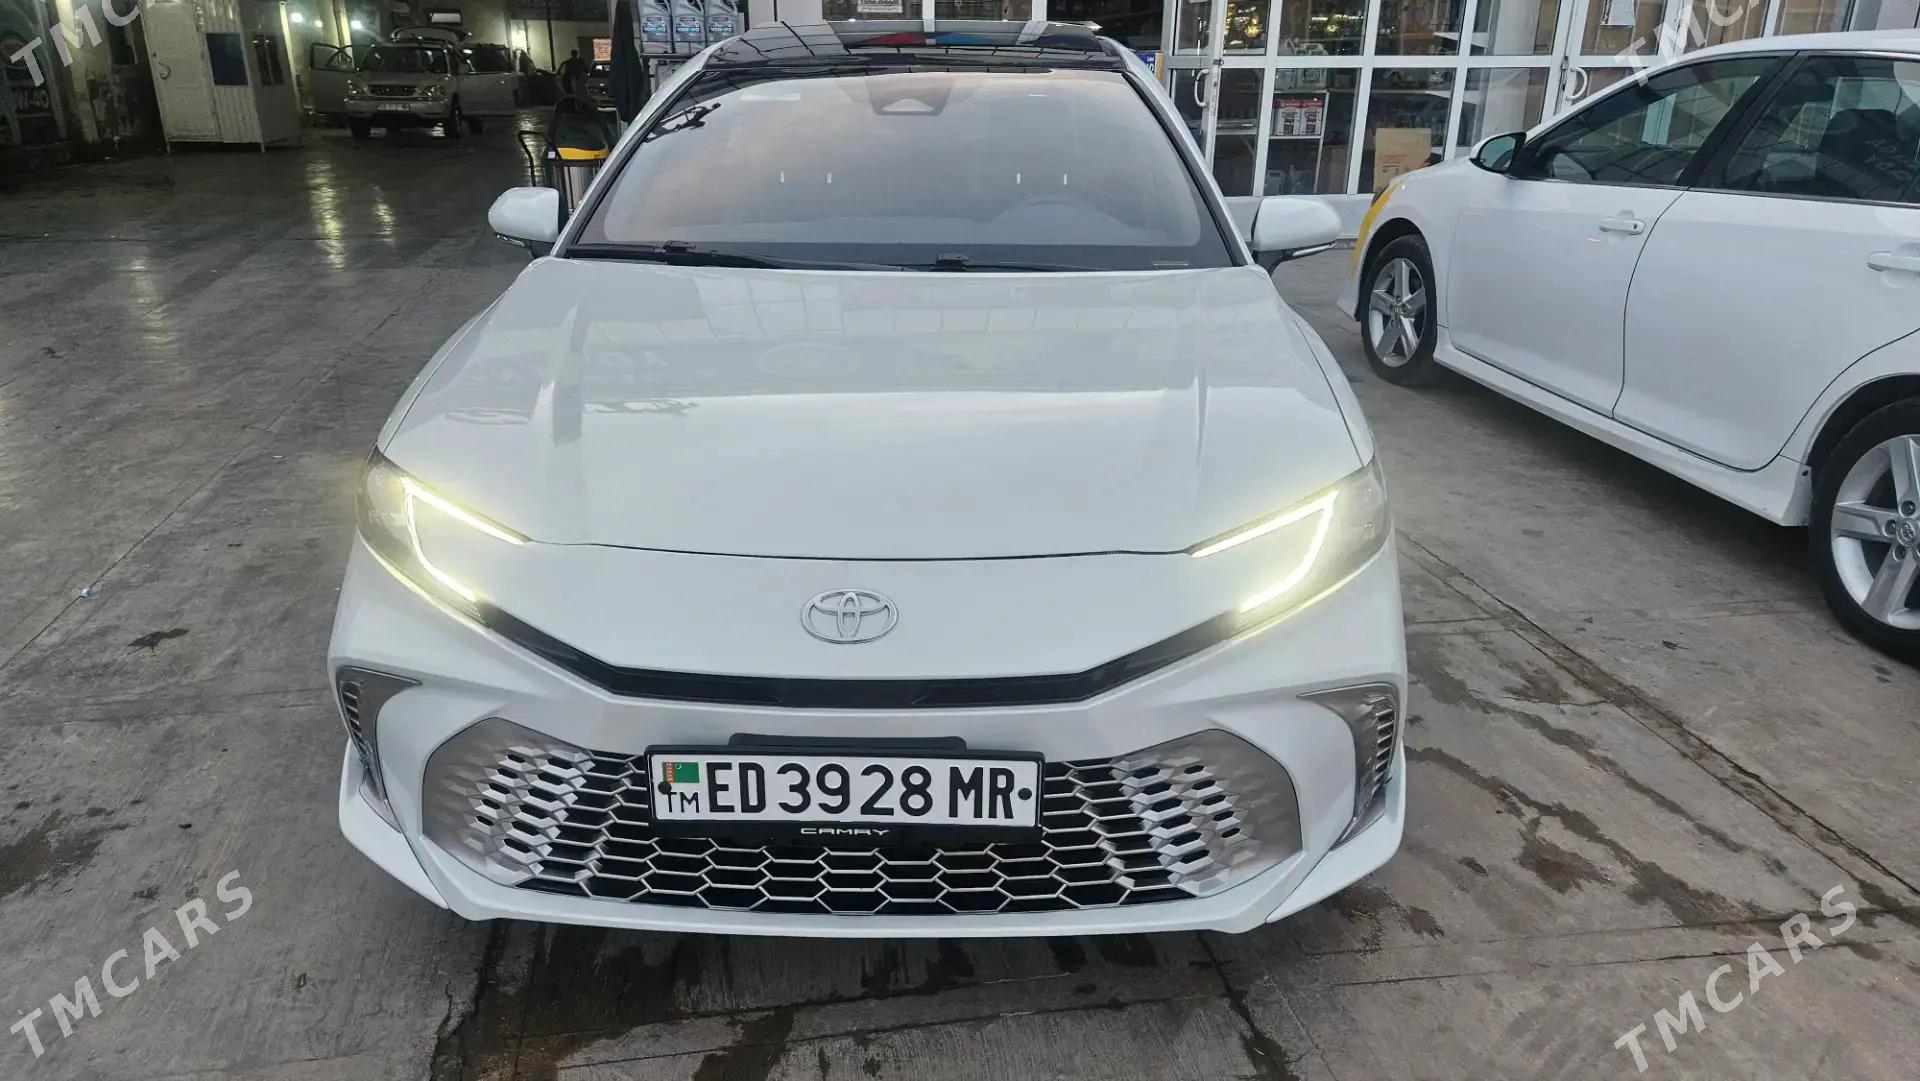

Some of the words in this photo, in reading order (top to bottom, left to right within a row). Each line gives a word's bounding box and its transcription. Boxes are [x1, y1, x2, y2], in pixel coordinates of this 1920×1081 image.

[706, 762, 767, 814] ED
[777, 762, 934, 817] 3928
[949, 766, 1015, 819] MR
[667, 791, 700, 813] TM
[800, 827, 891, 836] CAMRY
